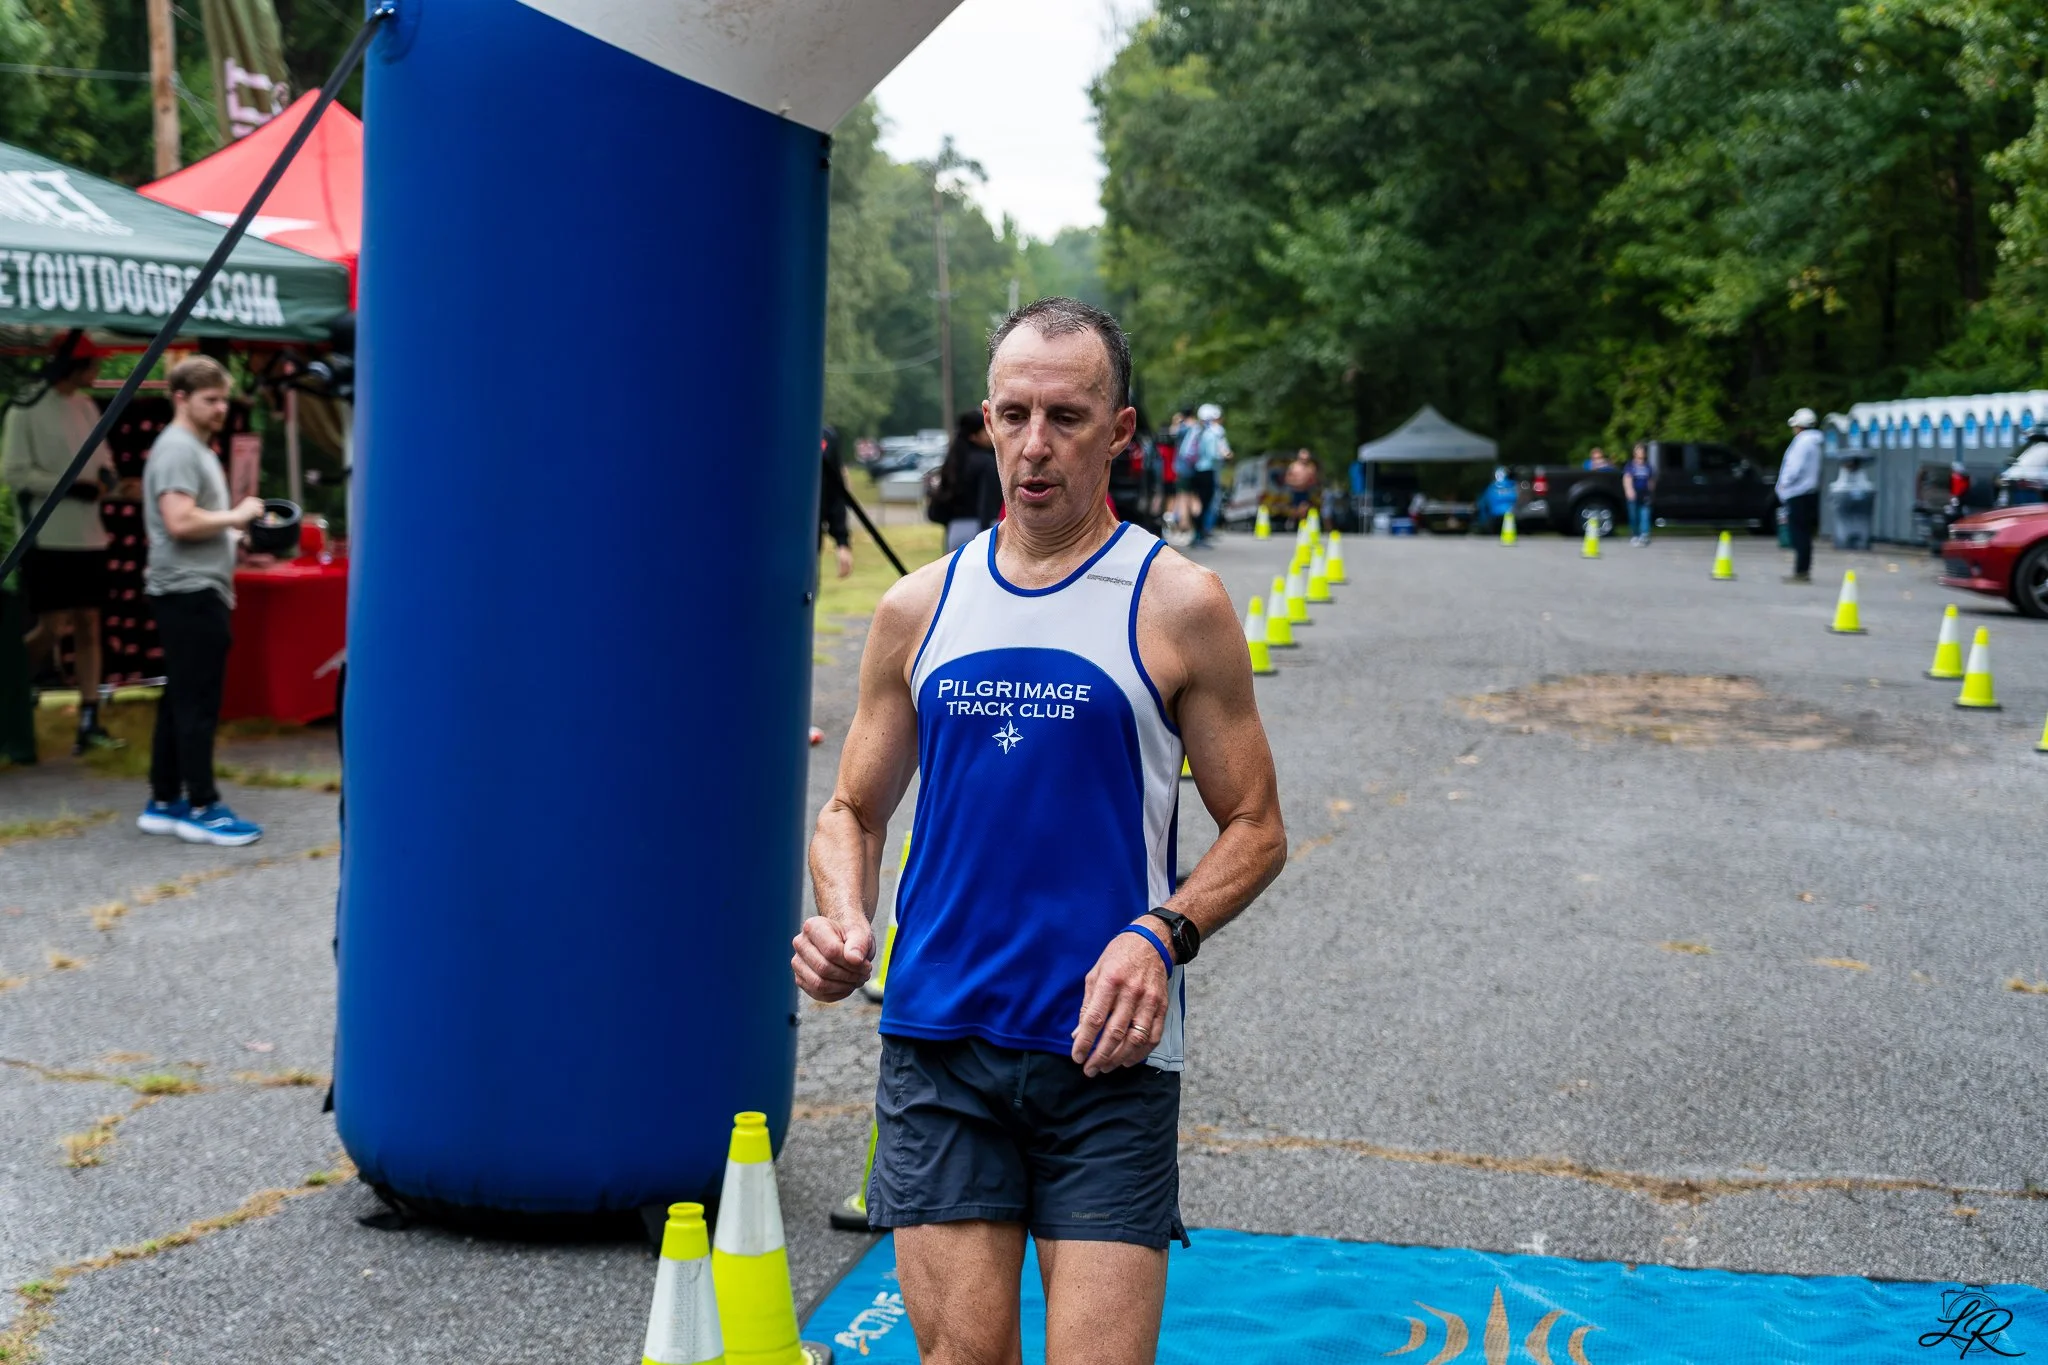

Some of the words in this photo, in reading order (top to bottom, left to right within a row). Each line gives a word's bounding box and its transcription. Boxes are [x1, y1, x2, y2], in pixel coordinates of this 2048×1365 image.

[937, 678, 1092, 702] PILGRIMAGE
[946, 701, 1014, 717] TRACK
[1018, 703, 1076, 720] CLUB
